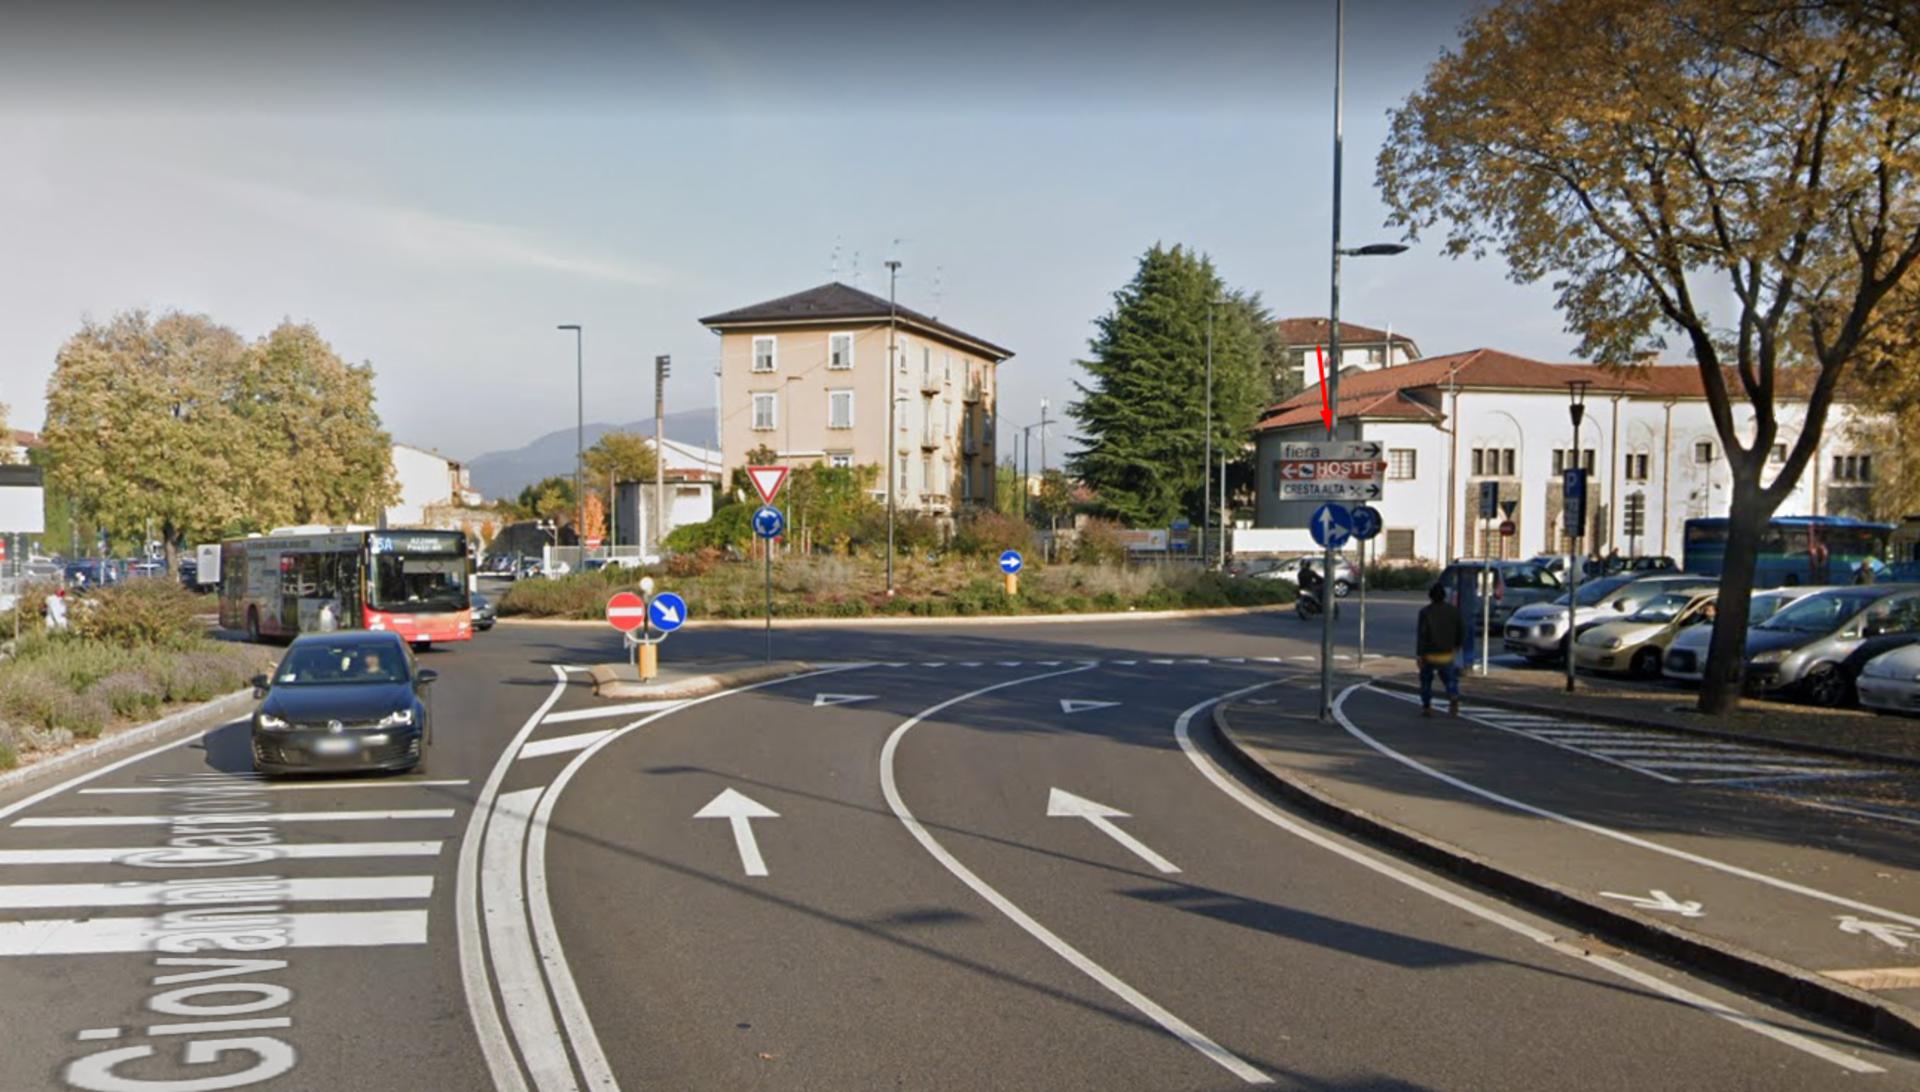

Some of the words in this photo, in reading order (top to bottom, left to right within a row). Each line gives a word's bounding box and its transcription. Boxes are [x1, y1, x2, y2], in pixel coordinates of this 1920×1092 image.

[1286, 444, 1320, 458] fiera
[1316, 461, 1382, 475] HOSTEL
[1284, 484, 1319, 495] CRESTA
[1322, 484, 1345, 495] ALTA
